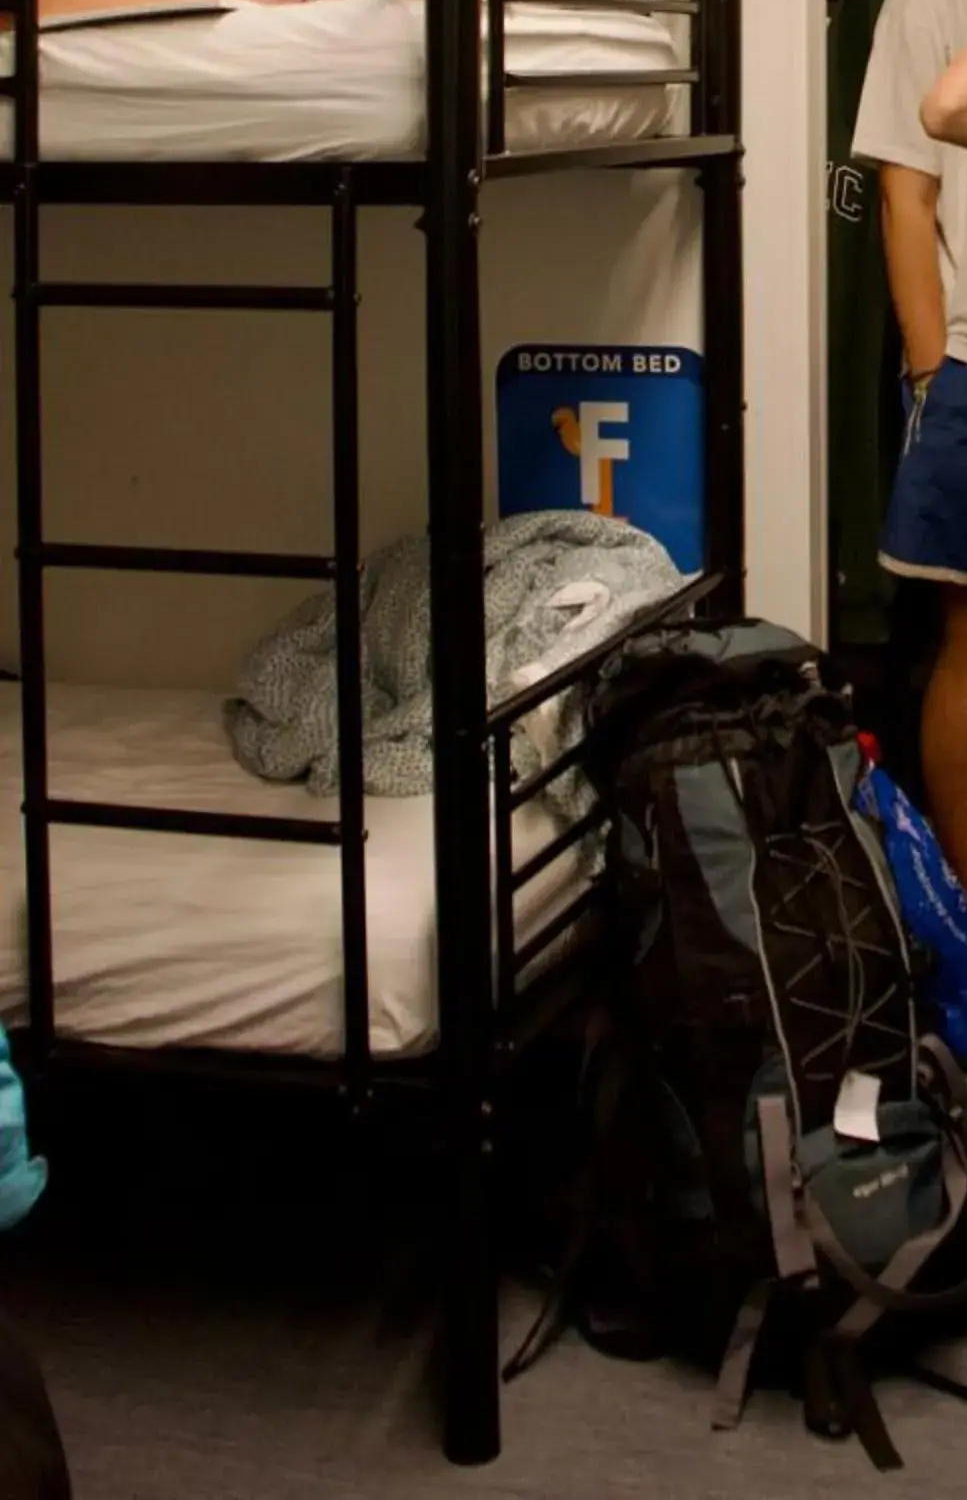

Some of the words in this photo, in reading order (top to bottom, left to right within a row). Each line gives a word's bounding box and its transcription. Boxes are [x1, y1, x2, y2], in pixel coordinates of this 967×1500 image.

[518, 352, 622, 371] BOTTOM
[632, 354, 681, 373] BED
[578, 401, 630, 505] F
